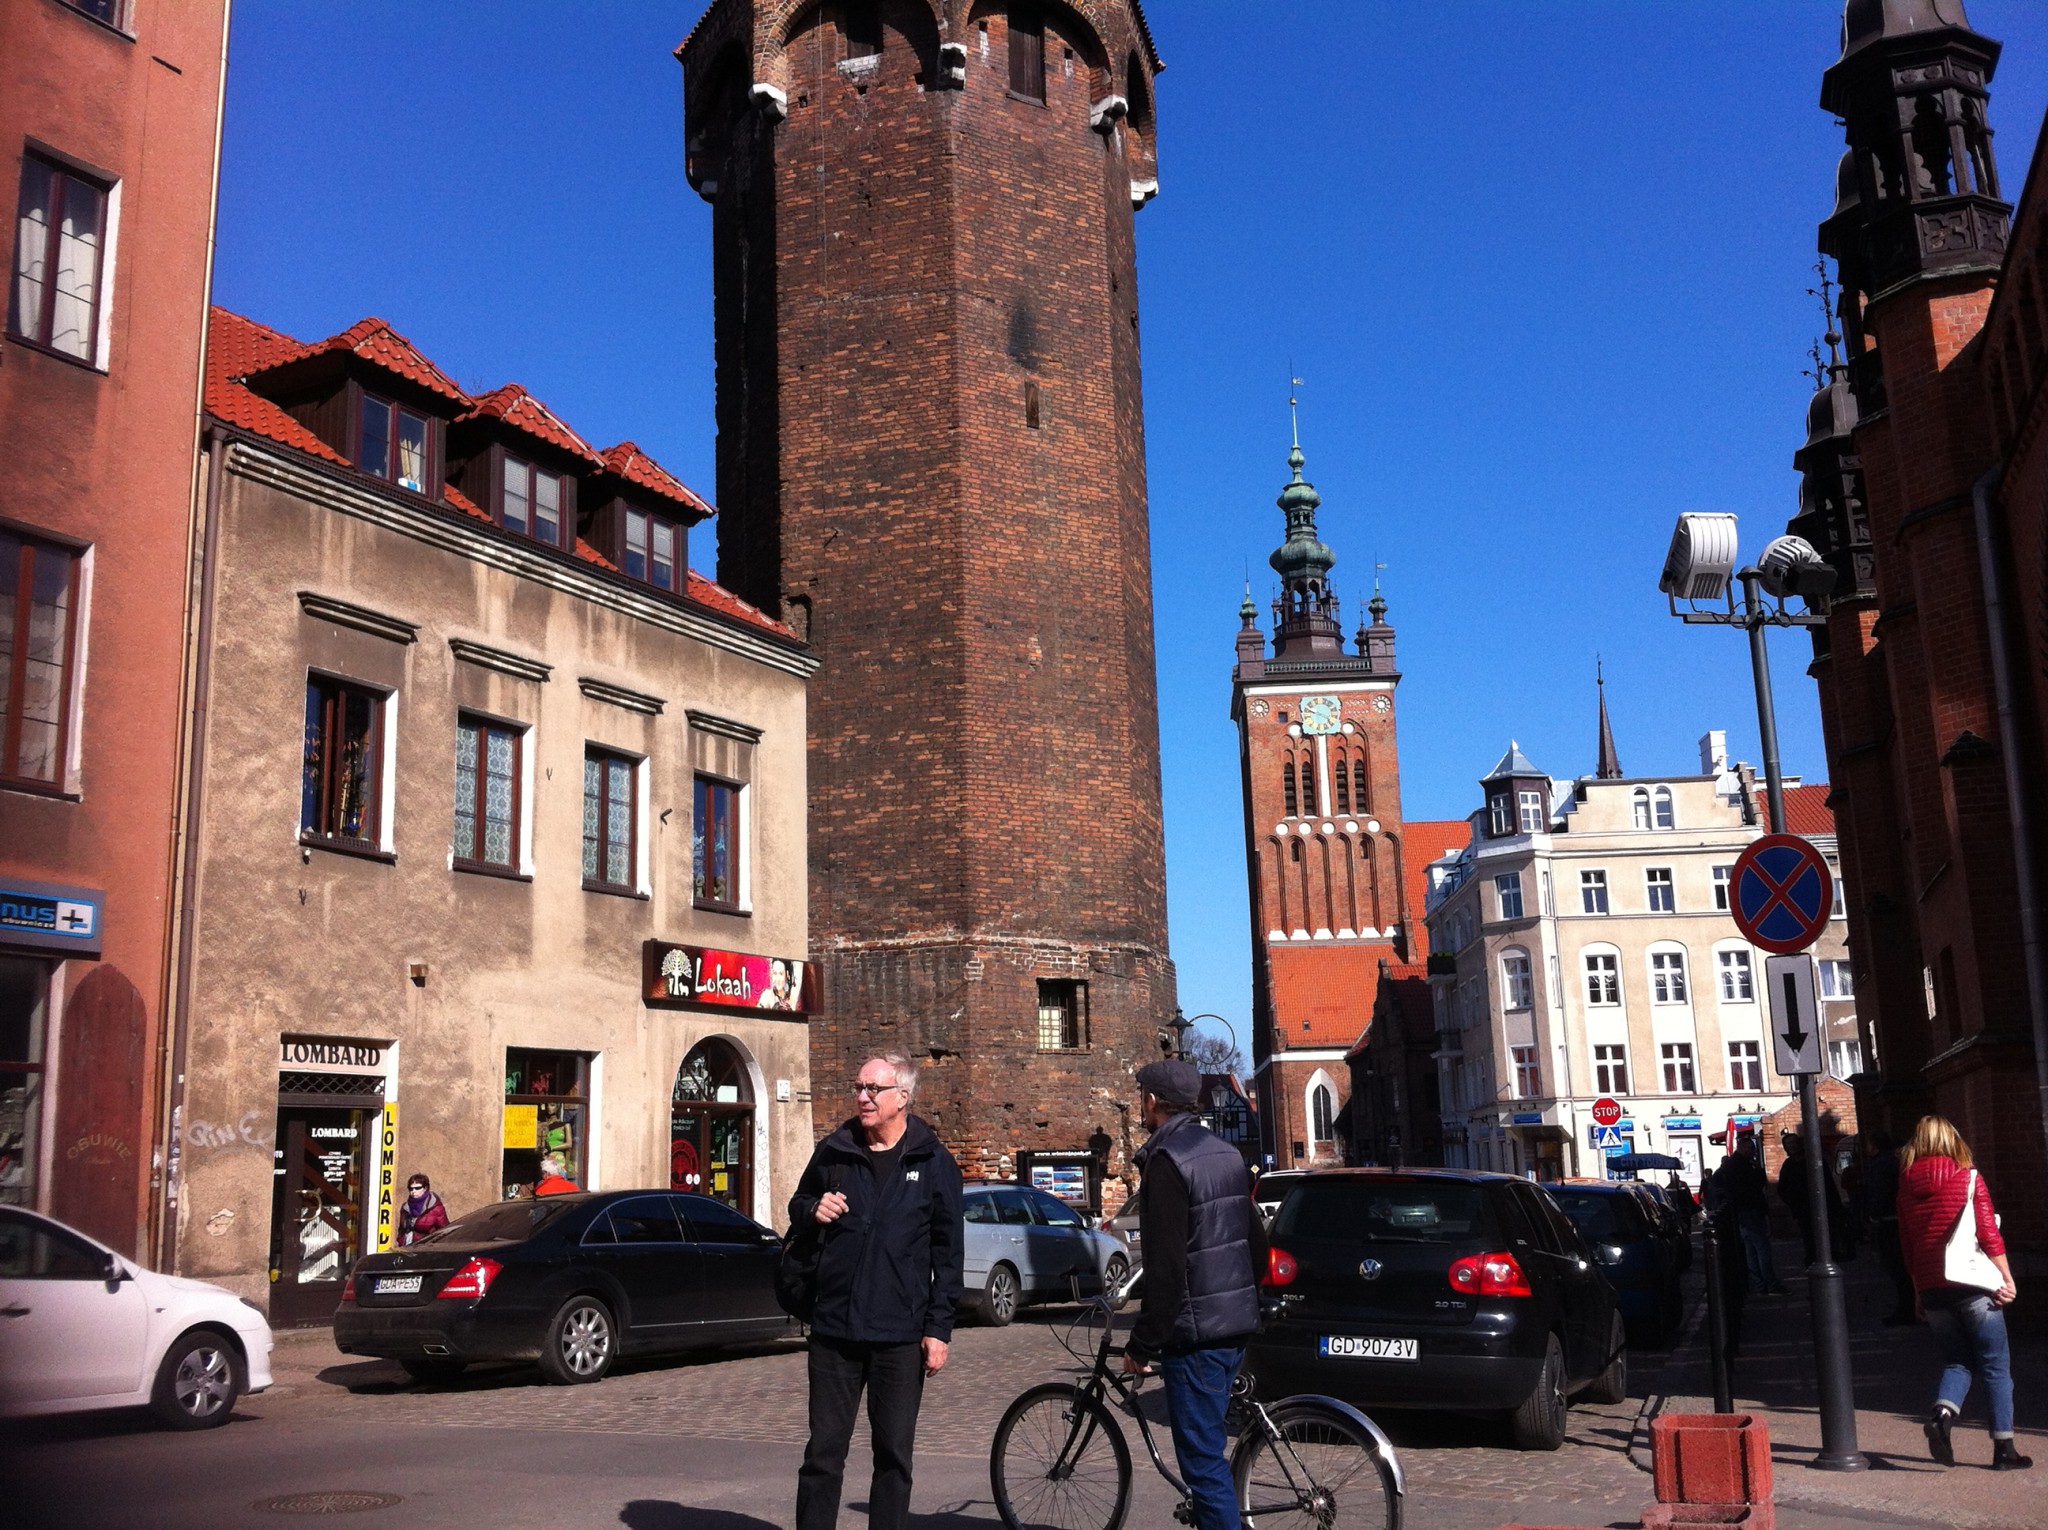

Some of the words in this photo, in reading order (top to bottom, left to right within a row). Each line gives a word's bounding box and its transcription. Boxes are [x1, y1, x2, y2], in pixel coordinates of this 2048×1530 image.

[695, 957, 751, 1000] Lokaah
[281, 1042, 381, 1067] LOMBARD
[1594, 1106, 1619, 1117] STOP
[311, 1127, 358, 1138] LOMBARD
[379, 1111, 395, 1245] LOMBARD
[1331, 1336, 1355, 1354] GD
[1361, 1338, 1415, 1358] 9073V
